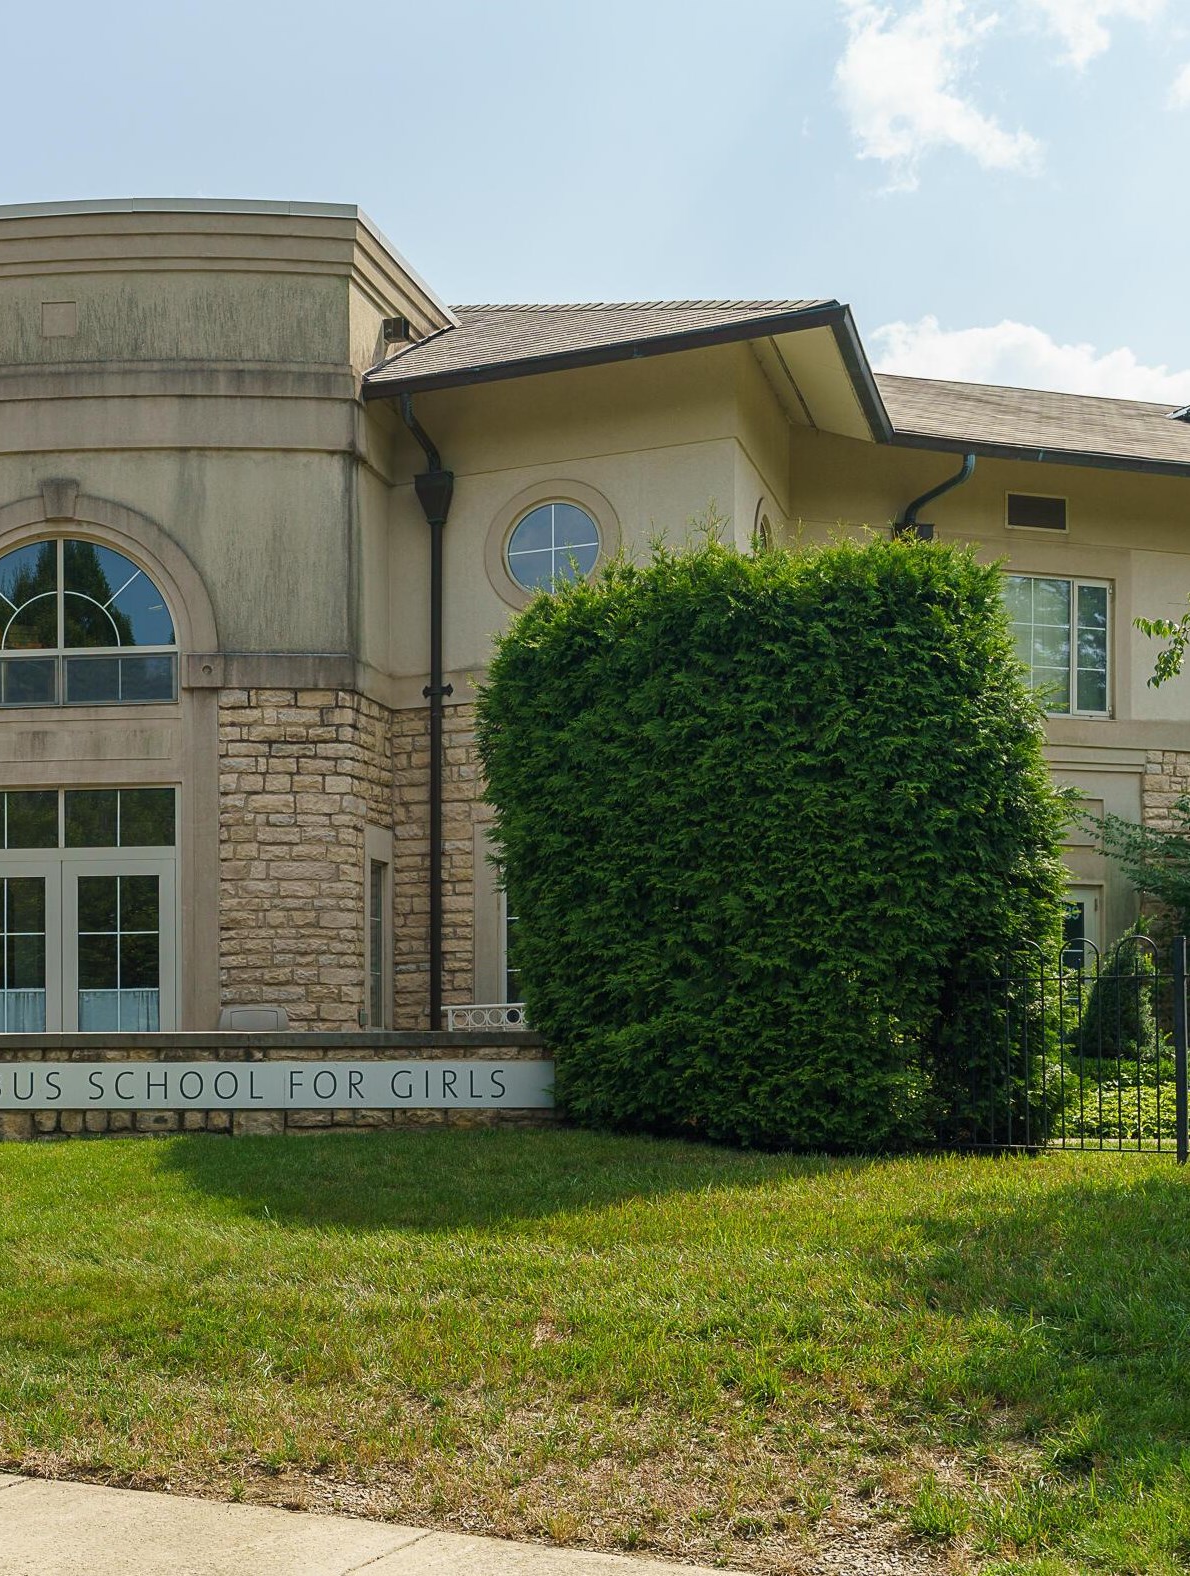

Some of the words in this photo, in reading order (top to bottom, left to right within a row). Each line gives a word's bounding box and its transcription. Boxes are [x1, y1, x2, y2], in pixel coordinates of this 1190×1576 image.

[88, 1070, 264, 1101] SCHOOL
[289, 1070, 365, 1100] FOR
[391, 1069, 507, 1100] GIRLS
